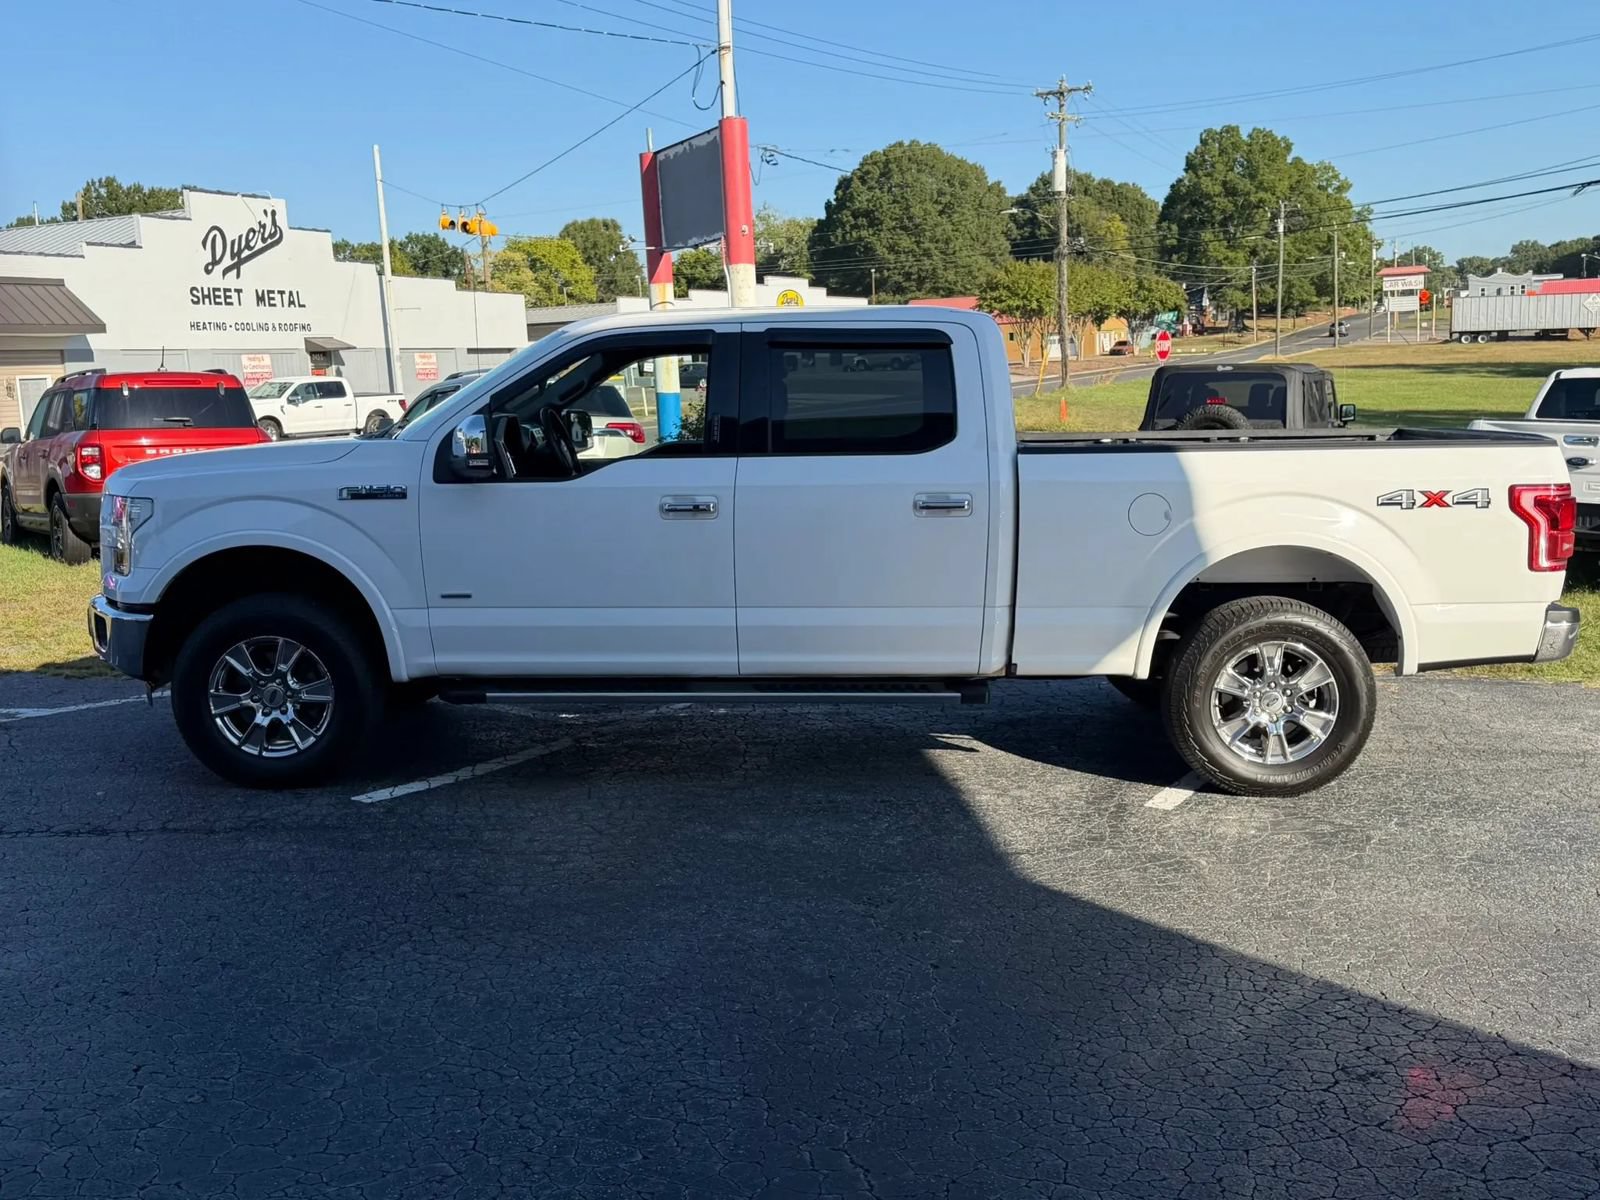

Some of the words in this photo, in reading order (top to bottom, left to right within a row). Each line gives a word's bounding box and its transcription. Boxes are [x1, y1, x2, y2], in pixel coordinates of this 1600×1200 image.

[201, 208, 284, 281] Dyer's
[1384, 280, 1399, 289] CAR
[1401, 279, 1423, 287] WASH
[189, 286, 243, 307] SHEET
[255, 288, 306, 308] METAL
[189, 321, 227, 332] HEATING
[234, 322, 269, 332] COOLING
[271, 323, 277, 332] &
[278, 322, 312, 332] ROOFING
[1156, 340, 1171, 352] STOP
